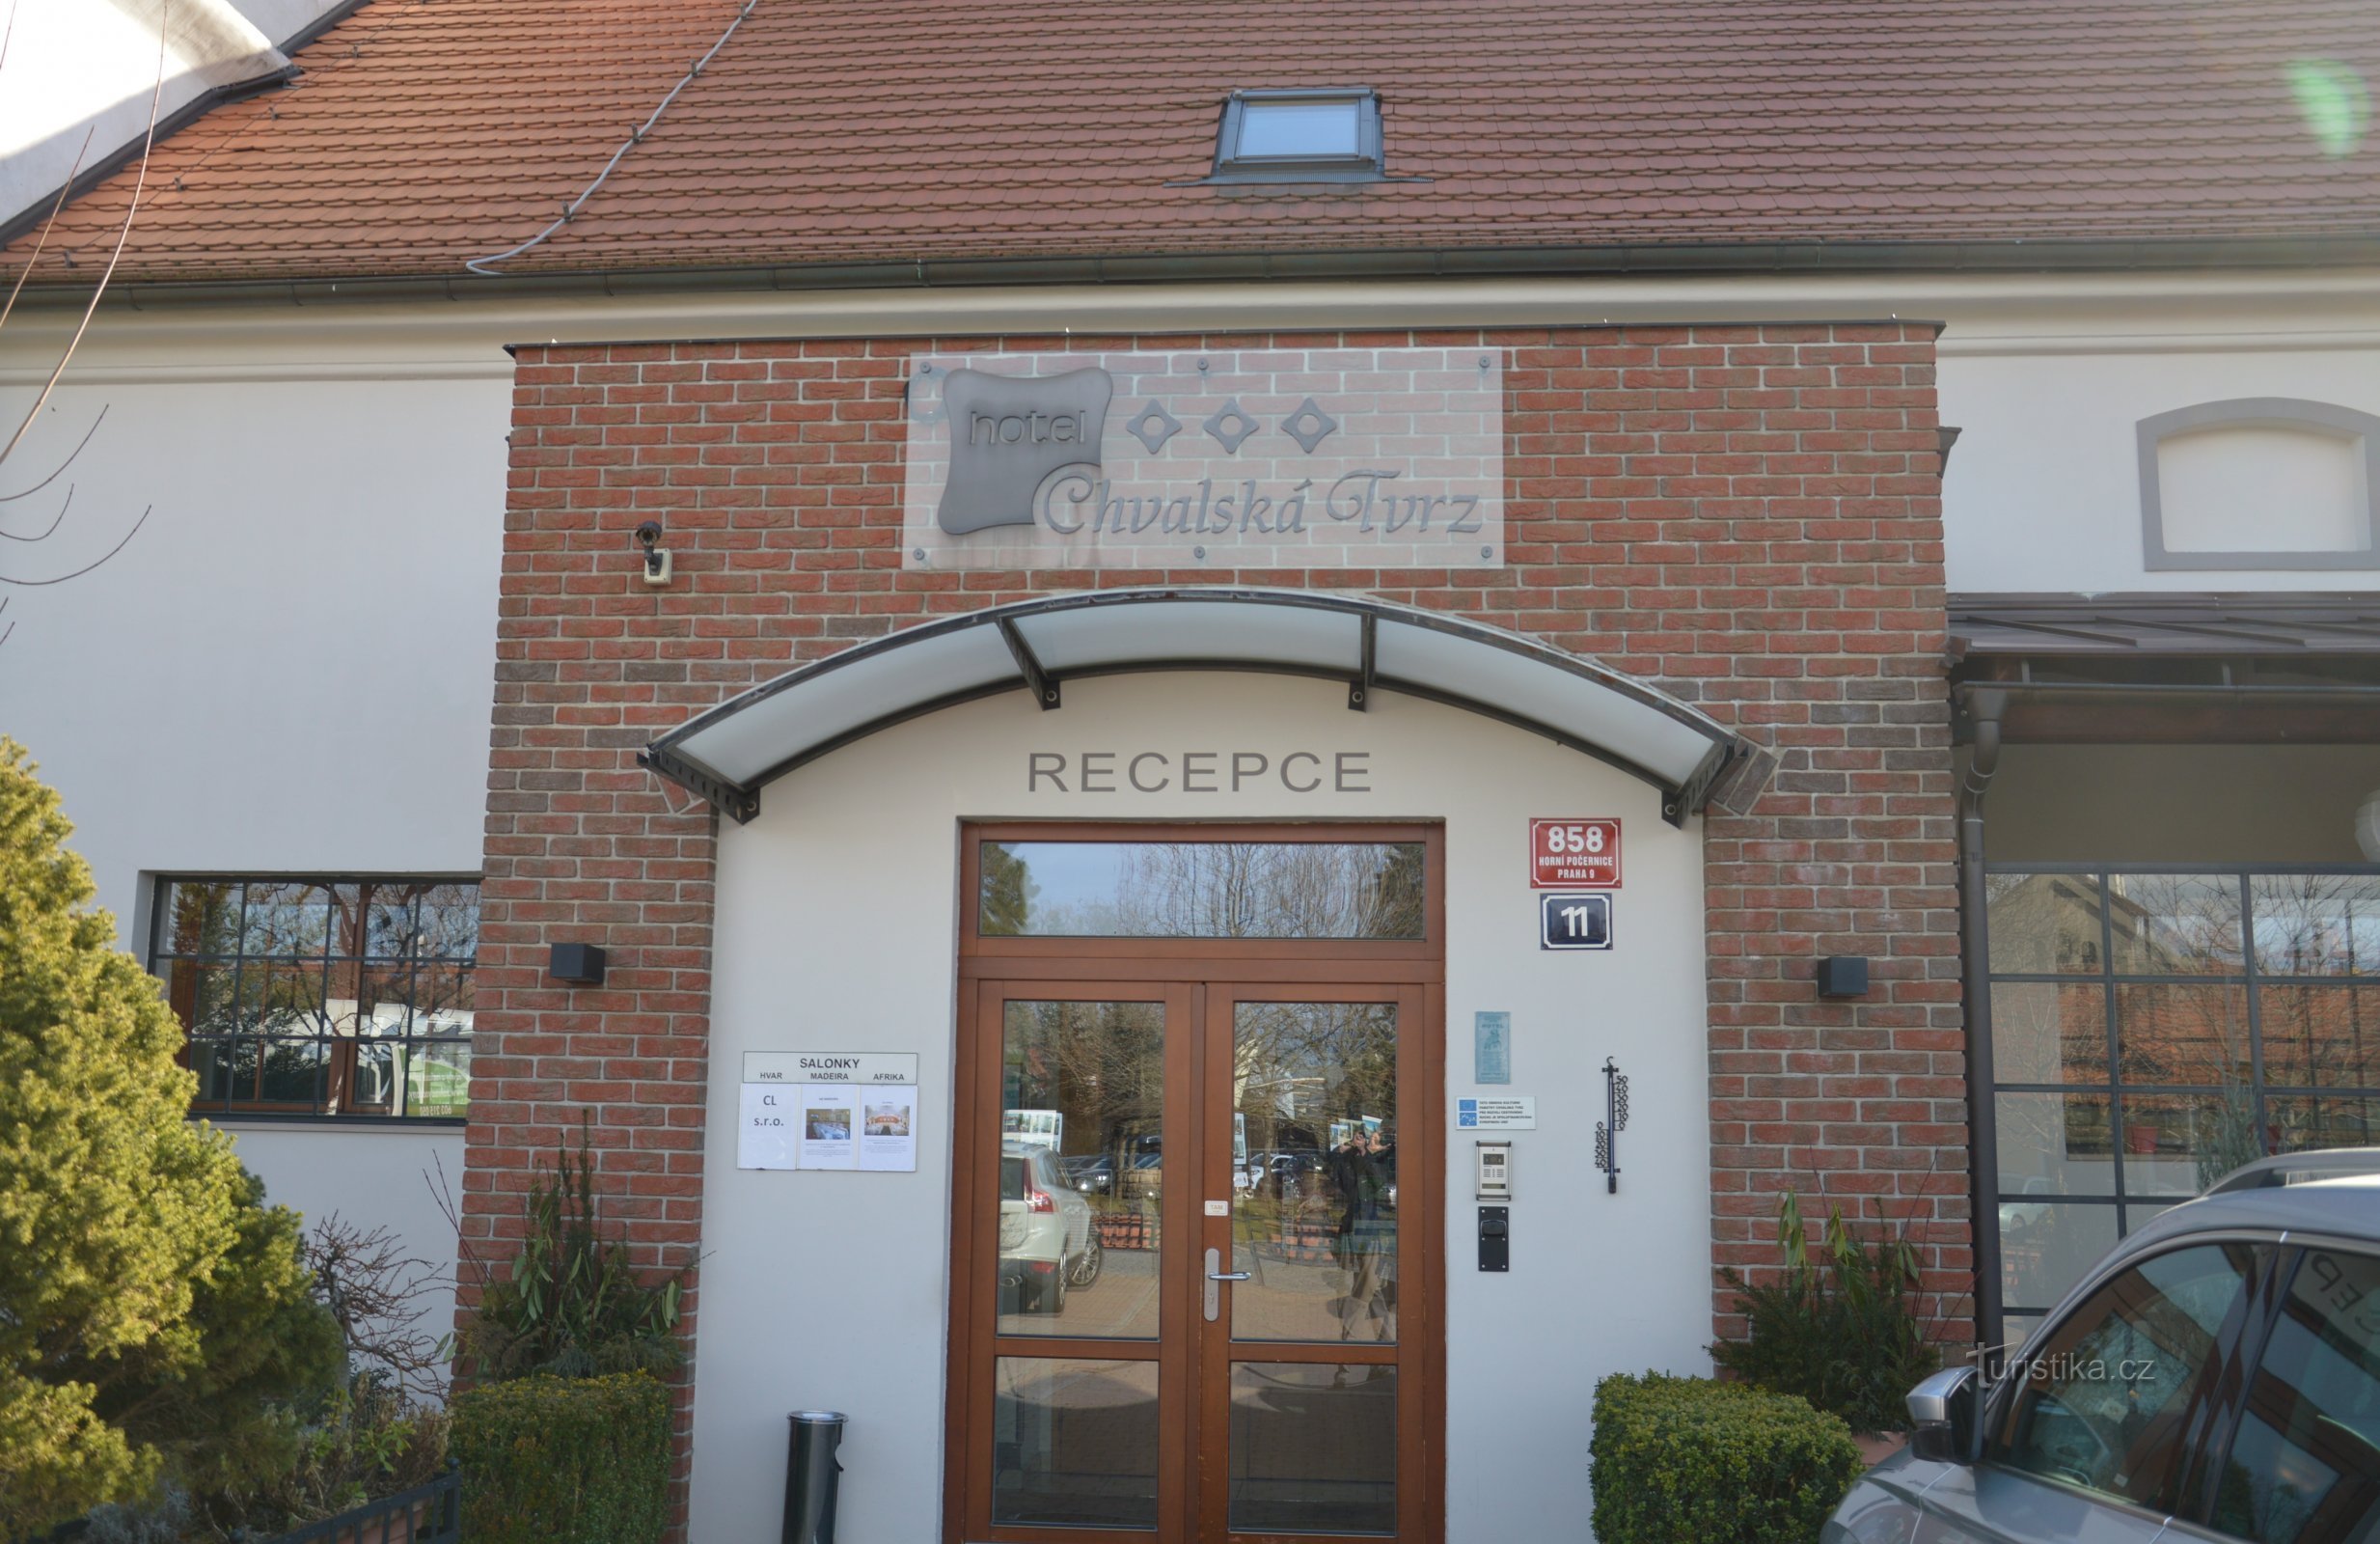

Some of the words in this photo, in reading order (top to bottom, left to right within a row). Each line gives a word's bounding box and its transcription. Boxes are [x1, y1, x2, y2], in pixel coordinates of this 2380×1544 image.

[968, 409, 1086, 446] hotel
[1042, 470, 1313, 535] Chvalská
[1326, 469, 1483, 534] Tvrz
[1028, 752, 1371, 792] RECEPCE
[1547, 826, 1603, 853] 858
[1539, 855, 1565, 866] HORNÍ
[1567, 855, 1613, 866] POČERNICE
[1557, 868, 1587, 879] PRAHA
[1590, 868, 1595, 879] 9
[1561, 906, 1588, 937] 11
[800, 1058, 860, 1068] SALONKY
[763, 1095, 777, 1106] CL
[753, 1117, 784, 1126] s.r.o.
[1618, 1113, 1628, 1121] 10
